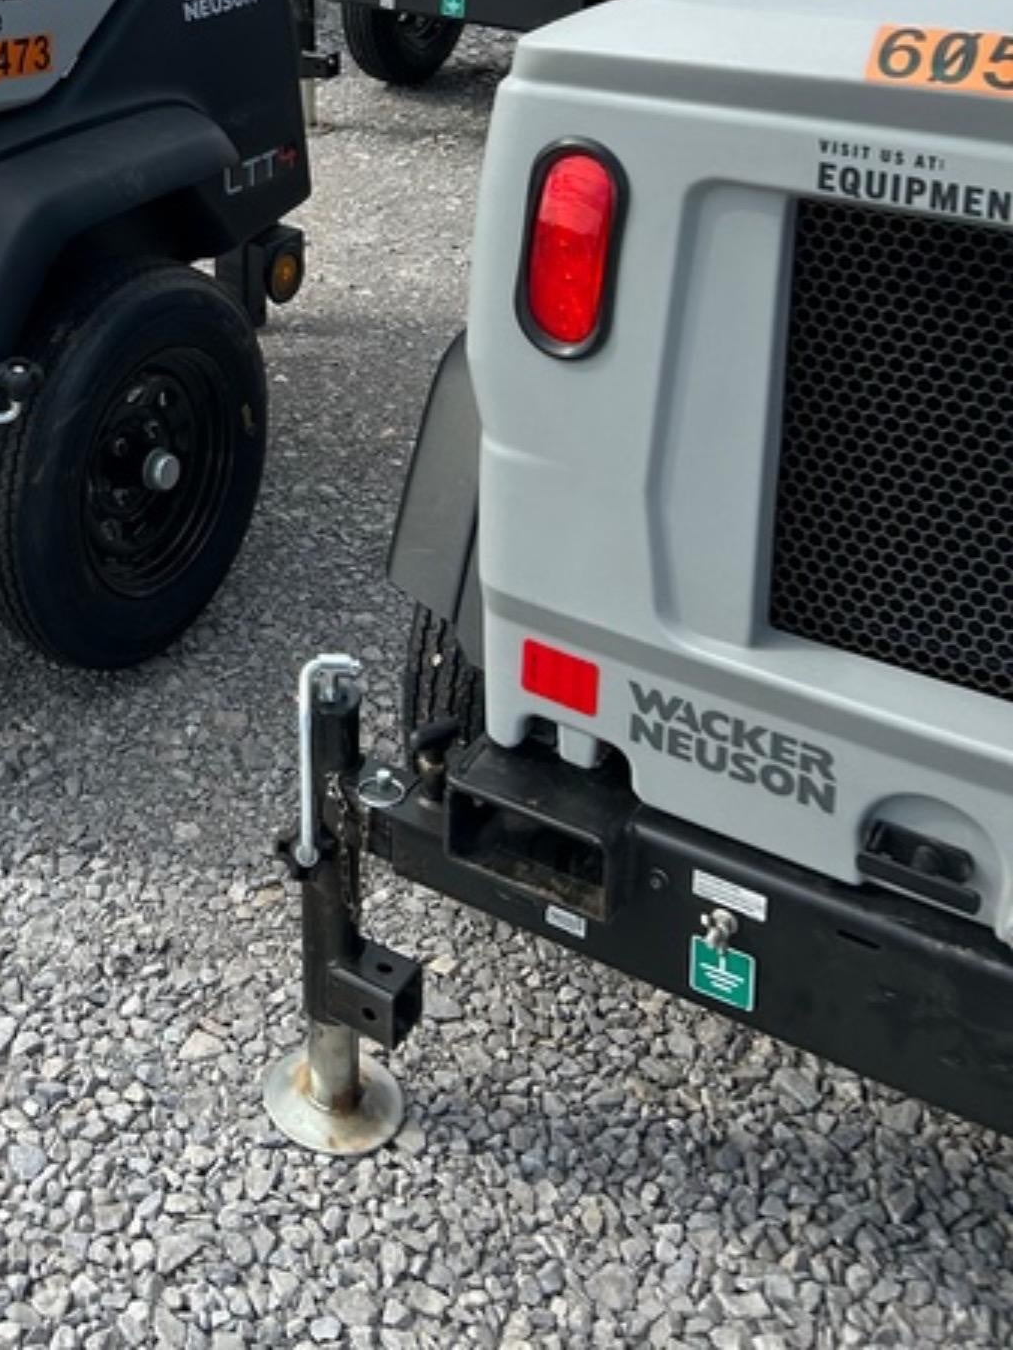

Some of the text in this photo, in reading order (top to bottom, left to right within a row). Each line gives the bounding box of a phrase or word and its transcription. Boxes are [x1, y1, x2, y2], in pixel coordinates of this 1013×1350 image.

[817, 161, 1012, 222] EQUIPMEN
[818, 138, 945, 171] VISIT US AT:
[628, 679, 837, 782] WACKER
[629, 712, 837, 815] NEUSON
